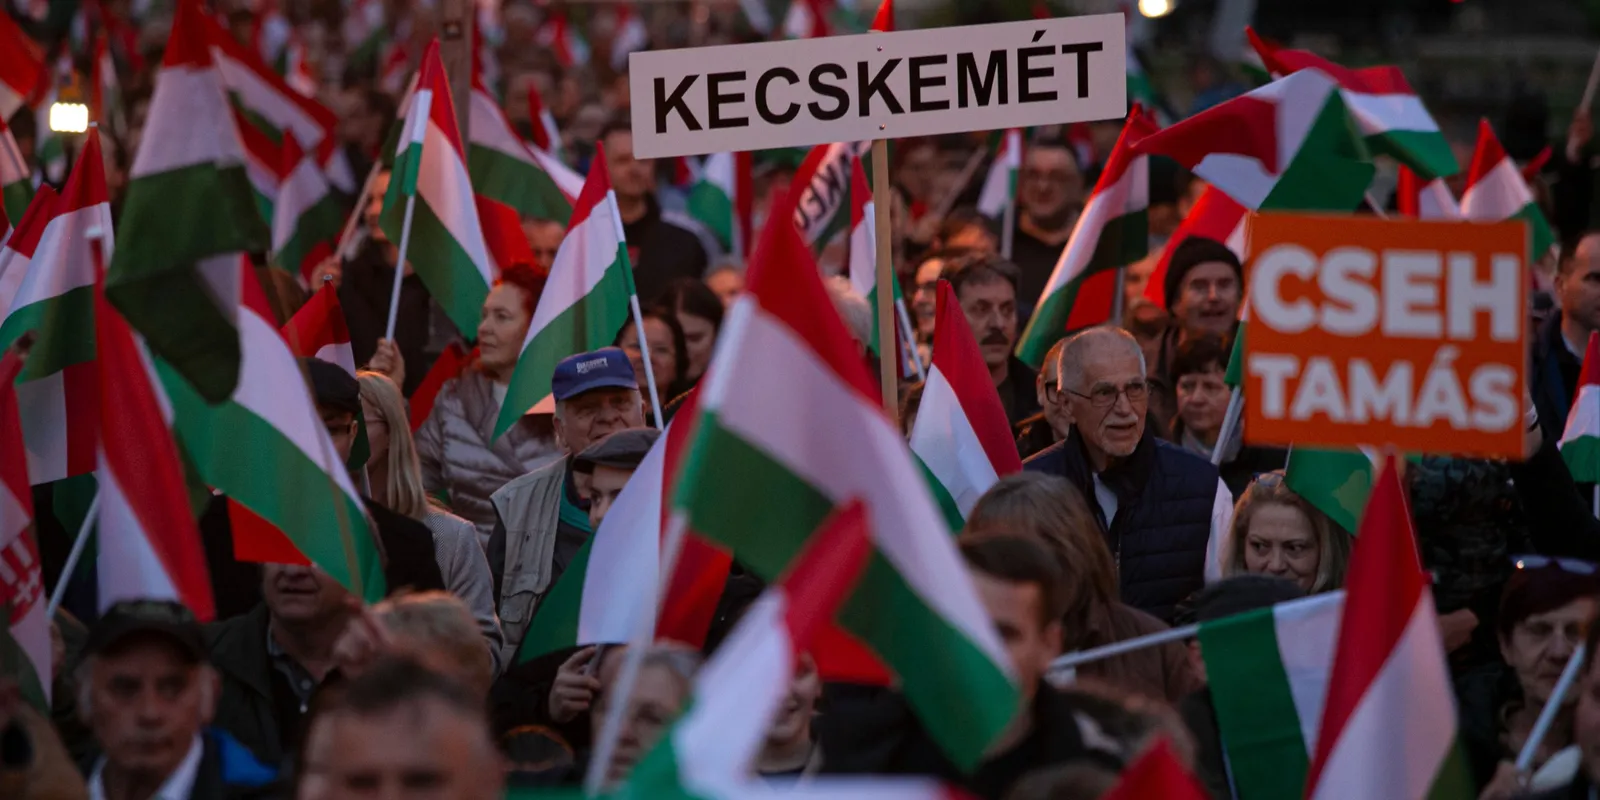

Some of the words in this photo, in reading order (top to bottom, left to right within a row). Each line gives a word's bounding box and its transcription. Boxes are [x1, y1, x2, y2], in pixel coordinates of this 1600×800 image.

[653, 29, 1103, 134] KECSKEMÉT
[1251, 243, 1521, 342] CSEH
[1249, 344, 1518, 433] TAMÁS
